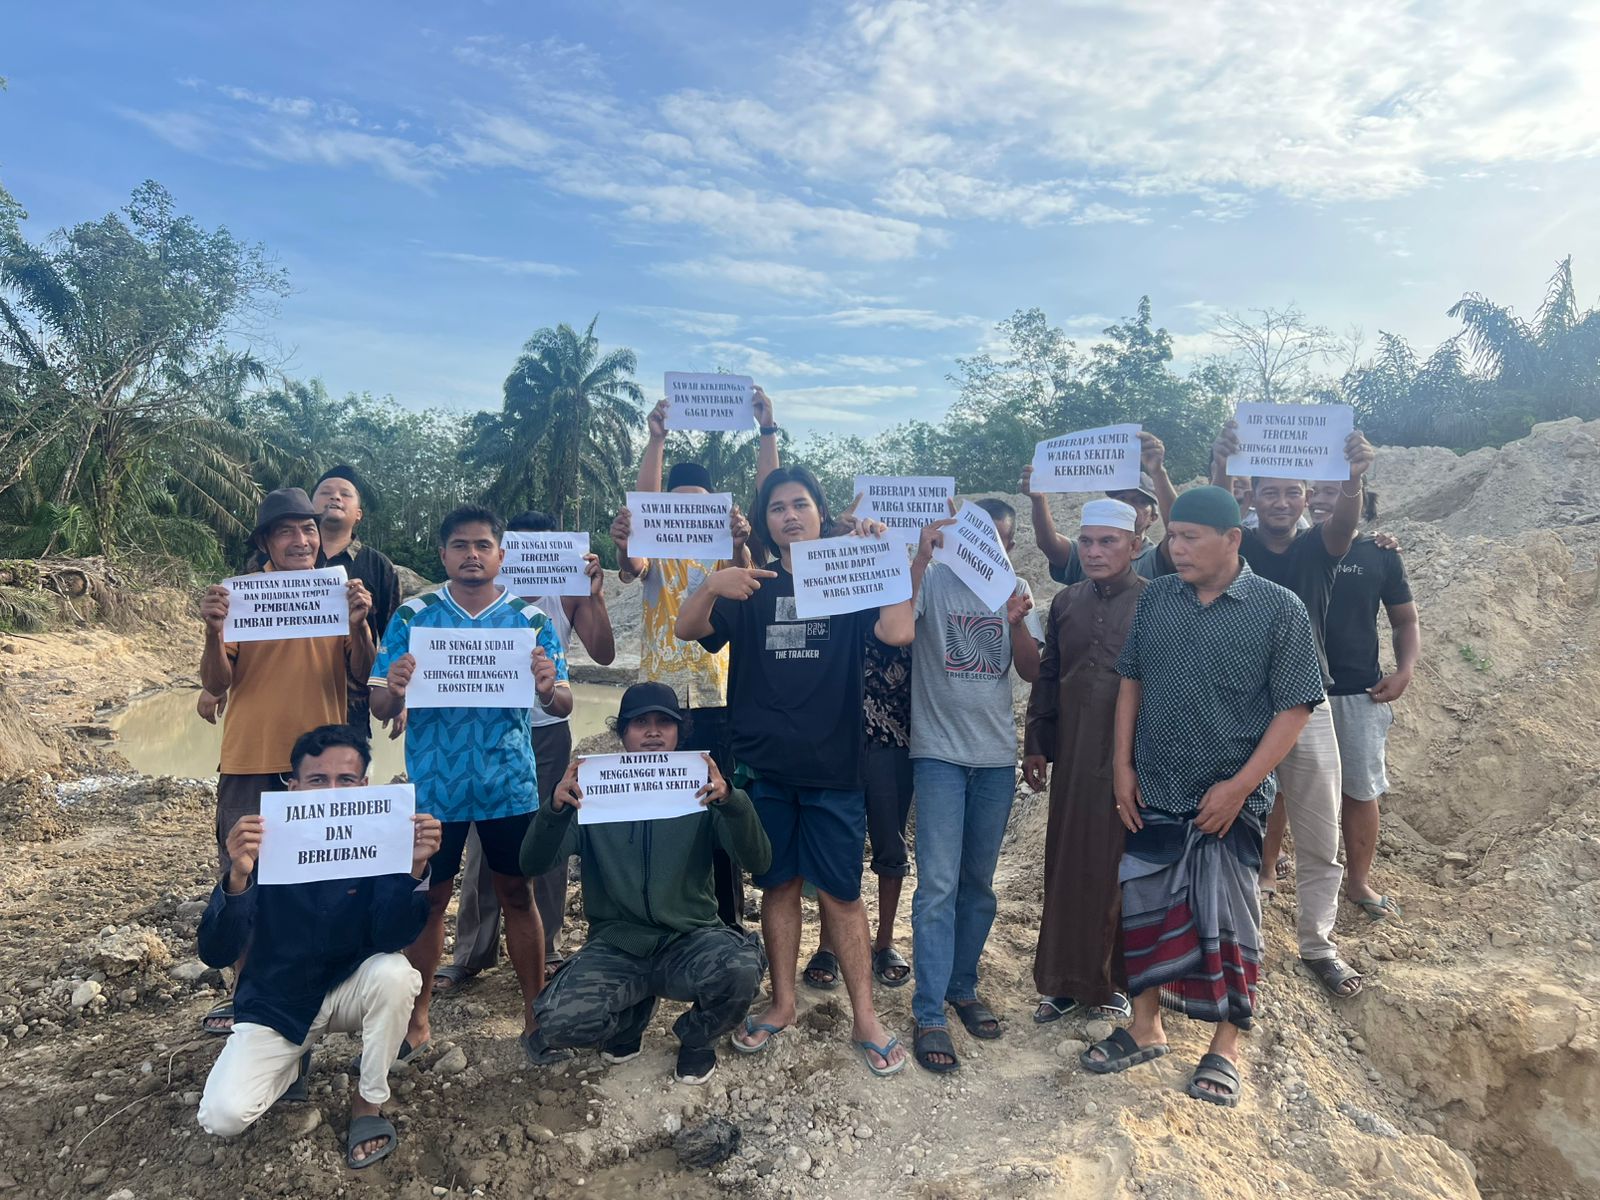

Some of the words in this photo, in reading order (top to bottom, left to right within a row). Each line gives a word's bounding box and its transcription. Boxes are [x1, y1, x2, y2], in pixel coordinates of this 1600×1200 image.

[672, 381, 698, 390] SAWAH
[700, 383, 746, 391] KEKERINGAN
[675, 395, 689, 404] DAN
[691, 395, 744, 404] MENYEBABKAN
[685, 409, 709, 417] GAGAL
[711, 409, 734, 417] PANEN
[1247, 415, 1263, 425] AIR
[1265, 416, 1296, 425] SUNGAI
[1298, 416, 1326, 425] SUDAH
[1263, 430, 1308, 440] TERCEMAR
[1047, 436, 1095, 449] BEBERAPA
[1097, 434, 1128, 444] SUMUR
[1048, 451, 1082, 461] WARGA
[1084, 449, 1125, 460] SEKITAR
[1239, 444, 1277, 453] SEHINGGA
[1279, 446, 1328, 455] HILANGGNYA
[1250, 457, 1293, 466] EKOSISTEM
[1294, 458, 1314, 466] IKAN
[1055, 465, 1115, 476] KEKERINGAN
[869, 485, 915, 496] BEBERAPA
[918, 487, 947, 497] SUMUR
[641, 504, 671, 513] SAWAH
[673, 504, 727, 514] KEKERINGAN
[872, 501, 904, 512] WARGA
[907, 502, 944, 513] SEKITAR
[644, 519, 662, 528] DAN
[663, 519, 725, 529] MENYEBABKAN
[963, 510, 984, 529] TANAH
[656, 533, 684, 543] GAGAL
[686, 534, 713, 543] PANEN
[506, 540, 519, 549] AIR
[521, 541, 548, 550] SUNGAI
[550, 541, 573, 550] SUDAH
[808, 548, 838, 560] BENTUK
[839, 546, 859, 557] ALAM
[860, 542, 890, 556] MENJADI
[521, 553, 559, 561] TERCEMAR
[502, 566, 535, 574] SEHINGGA
[536, 566, 578, 574] HILANGGNYA
[825, 560, 849, 571] DANAU
[851, 558, 875, 570] DAPAT
[513, 577, 549, 585] EKOSISTEM
[550, 576, 566, 584] IKAN
[803, 575, 848, 588] MENGANCAM
[849, 567, 900, 583] KESELAMATAN
[232, 579, 280, 591] PEMUTUSAN
[282, 578, 311, 588] ALIRAN
[313, 577, 340, 587] SUNGAI
[244, 592, 260, 601] DAN
[261, 590, 300, 600] DIJADIKAN
[302, 589, 329, 598] TEMPAT
[822, 587, 851, 599] WARGA
[853, 583, 884, 594] SEKITAR
[254, 600, 321, 612] PEMBUANGAN
[234, 616, 273, 629] LIMBAH
[276, 614, 339, 627] PERUSAHAAN
[429, 640, 447, 651] AIR
[449, 640, 482, 651] SUNGAI
[485, 640, 514, 650] SUDAH
[775, 650, 787, 659] THE
[788, 649, 820, 659] TRACKER
[448, 655, 496, 665] TERCEMAR
[423, 670, 465, 680] SEHINGGA
[467, 670, 519, 680] HILANGGNYA
[438, 683, 483, 693] EKOSISTEM
[485, 683, 504, 693] IKAN
[620, 754, 669, 763] AKTIVITAS
[600, 768, 656, 780] MENGGANGGU
[658, 768, 687, 777] WAKTU
[586, 782, 632, 794] ISTIRAHAT
[634, 781, 663, 792] WARGA
[665, 780, 700, 790] SEKITAR
[285, 804, 326, 823] JALAN
[329, 799, 392, 817] BERDEBU
[325, 825, 353, 841] DAN
[298, 845, 377, 865] BERLUBANG
